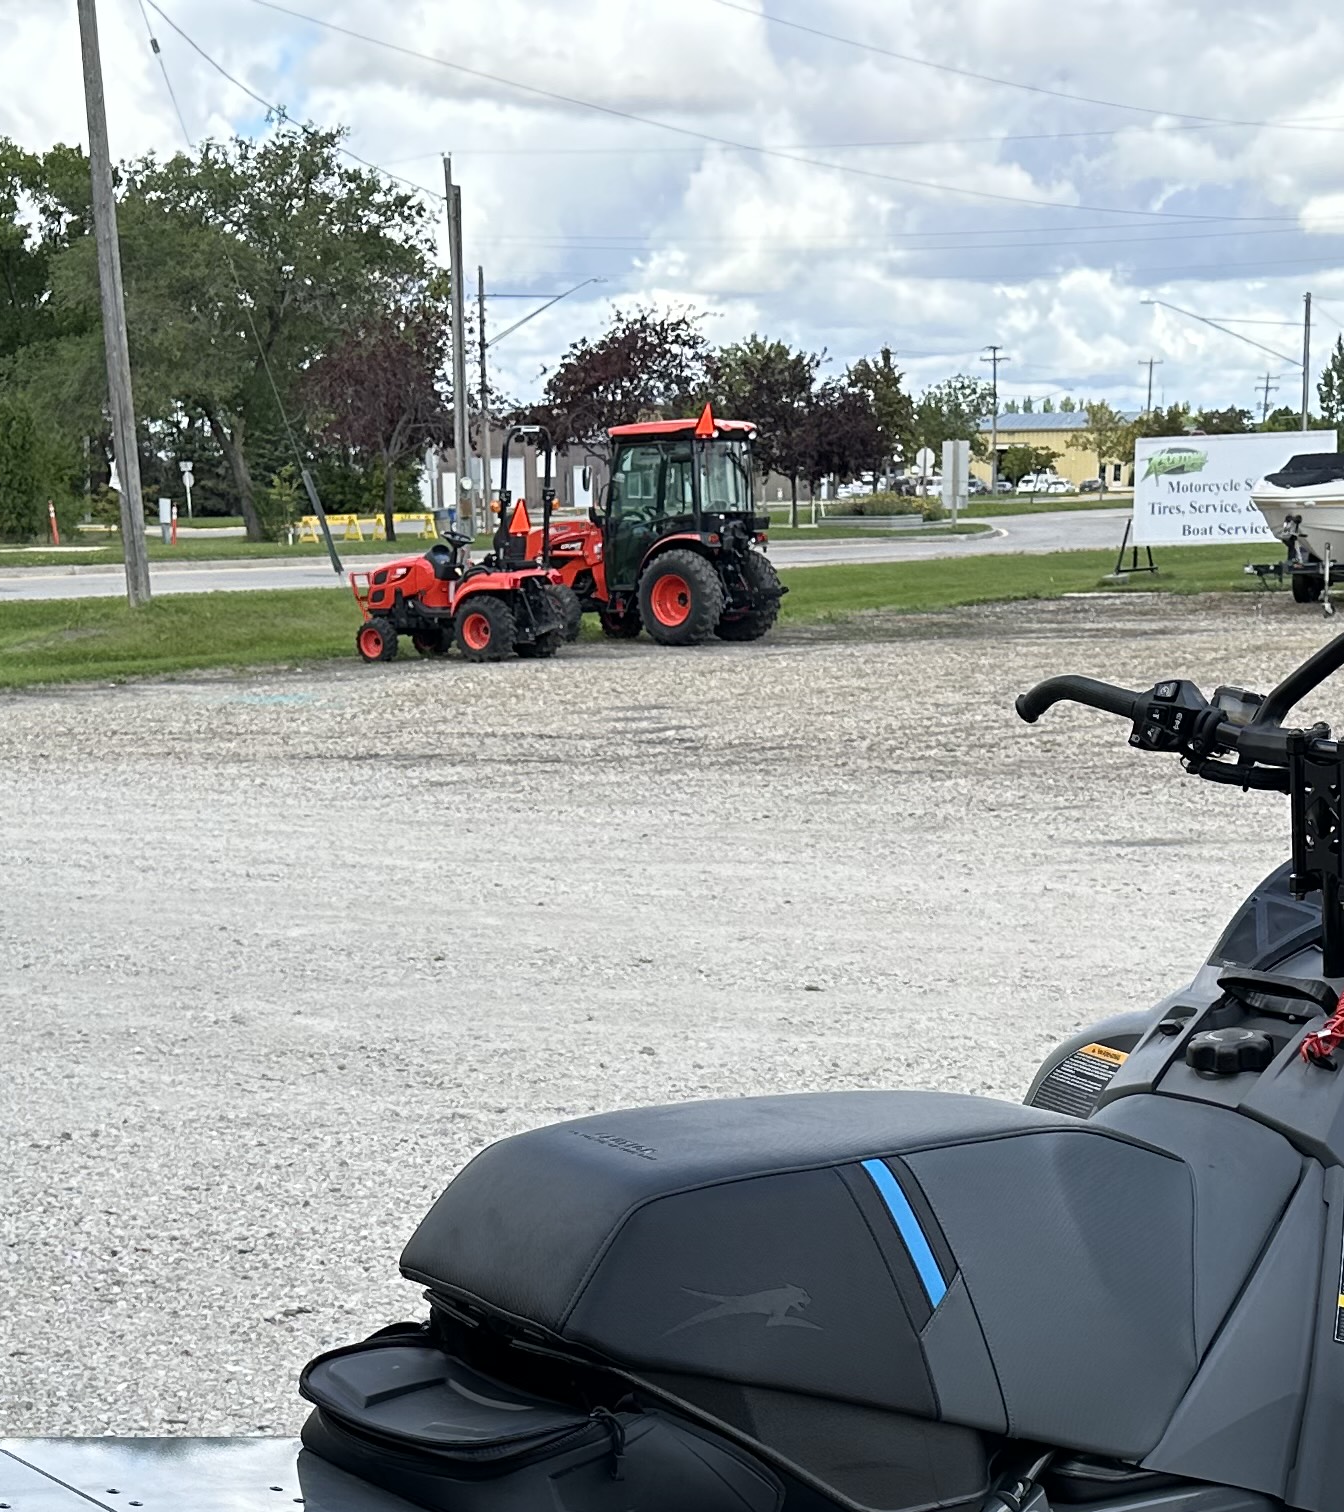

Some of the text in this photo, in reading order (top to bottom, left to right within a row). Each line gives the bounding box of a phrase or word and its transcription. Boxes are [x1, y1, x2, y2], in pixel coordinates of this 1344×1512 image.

[1167, 478, 1256, 496] Motorcycle S
[1149, 501, 1186, 516] Tires,
[1189, 500, 1242, 515] Service,
[1182, 522, 1269, 537] Boat Service
